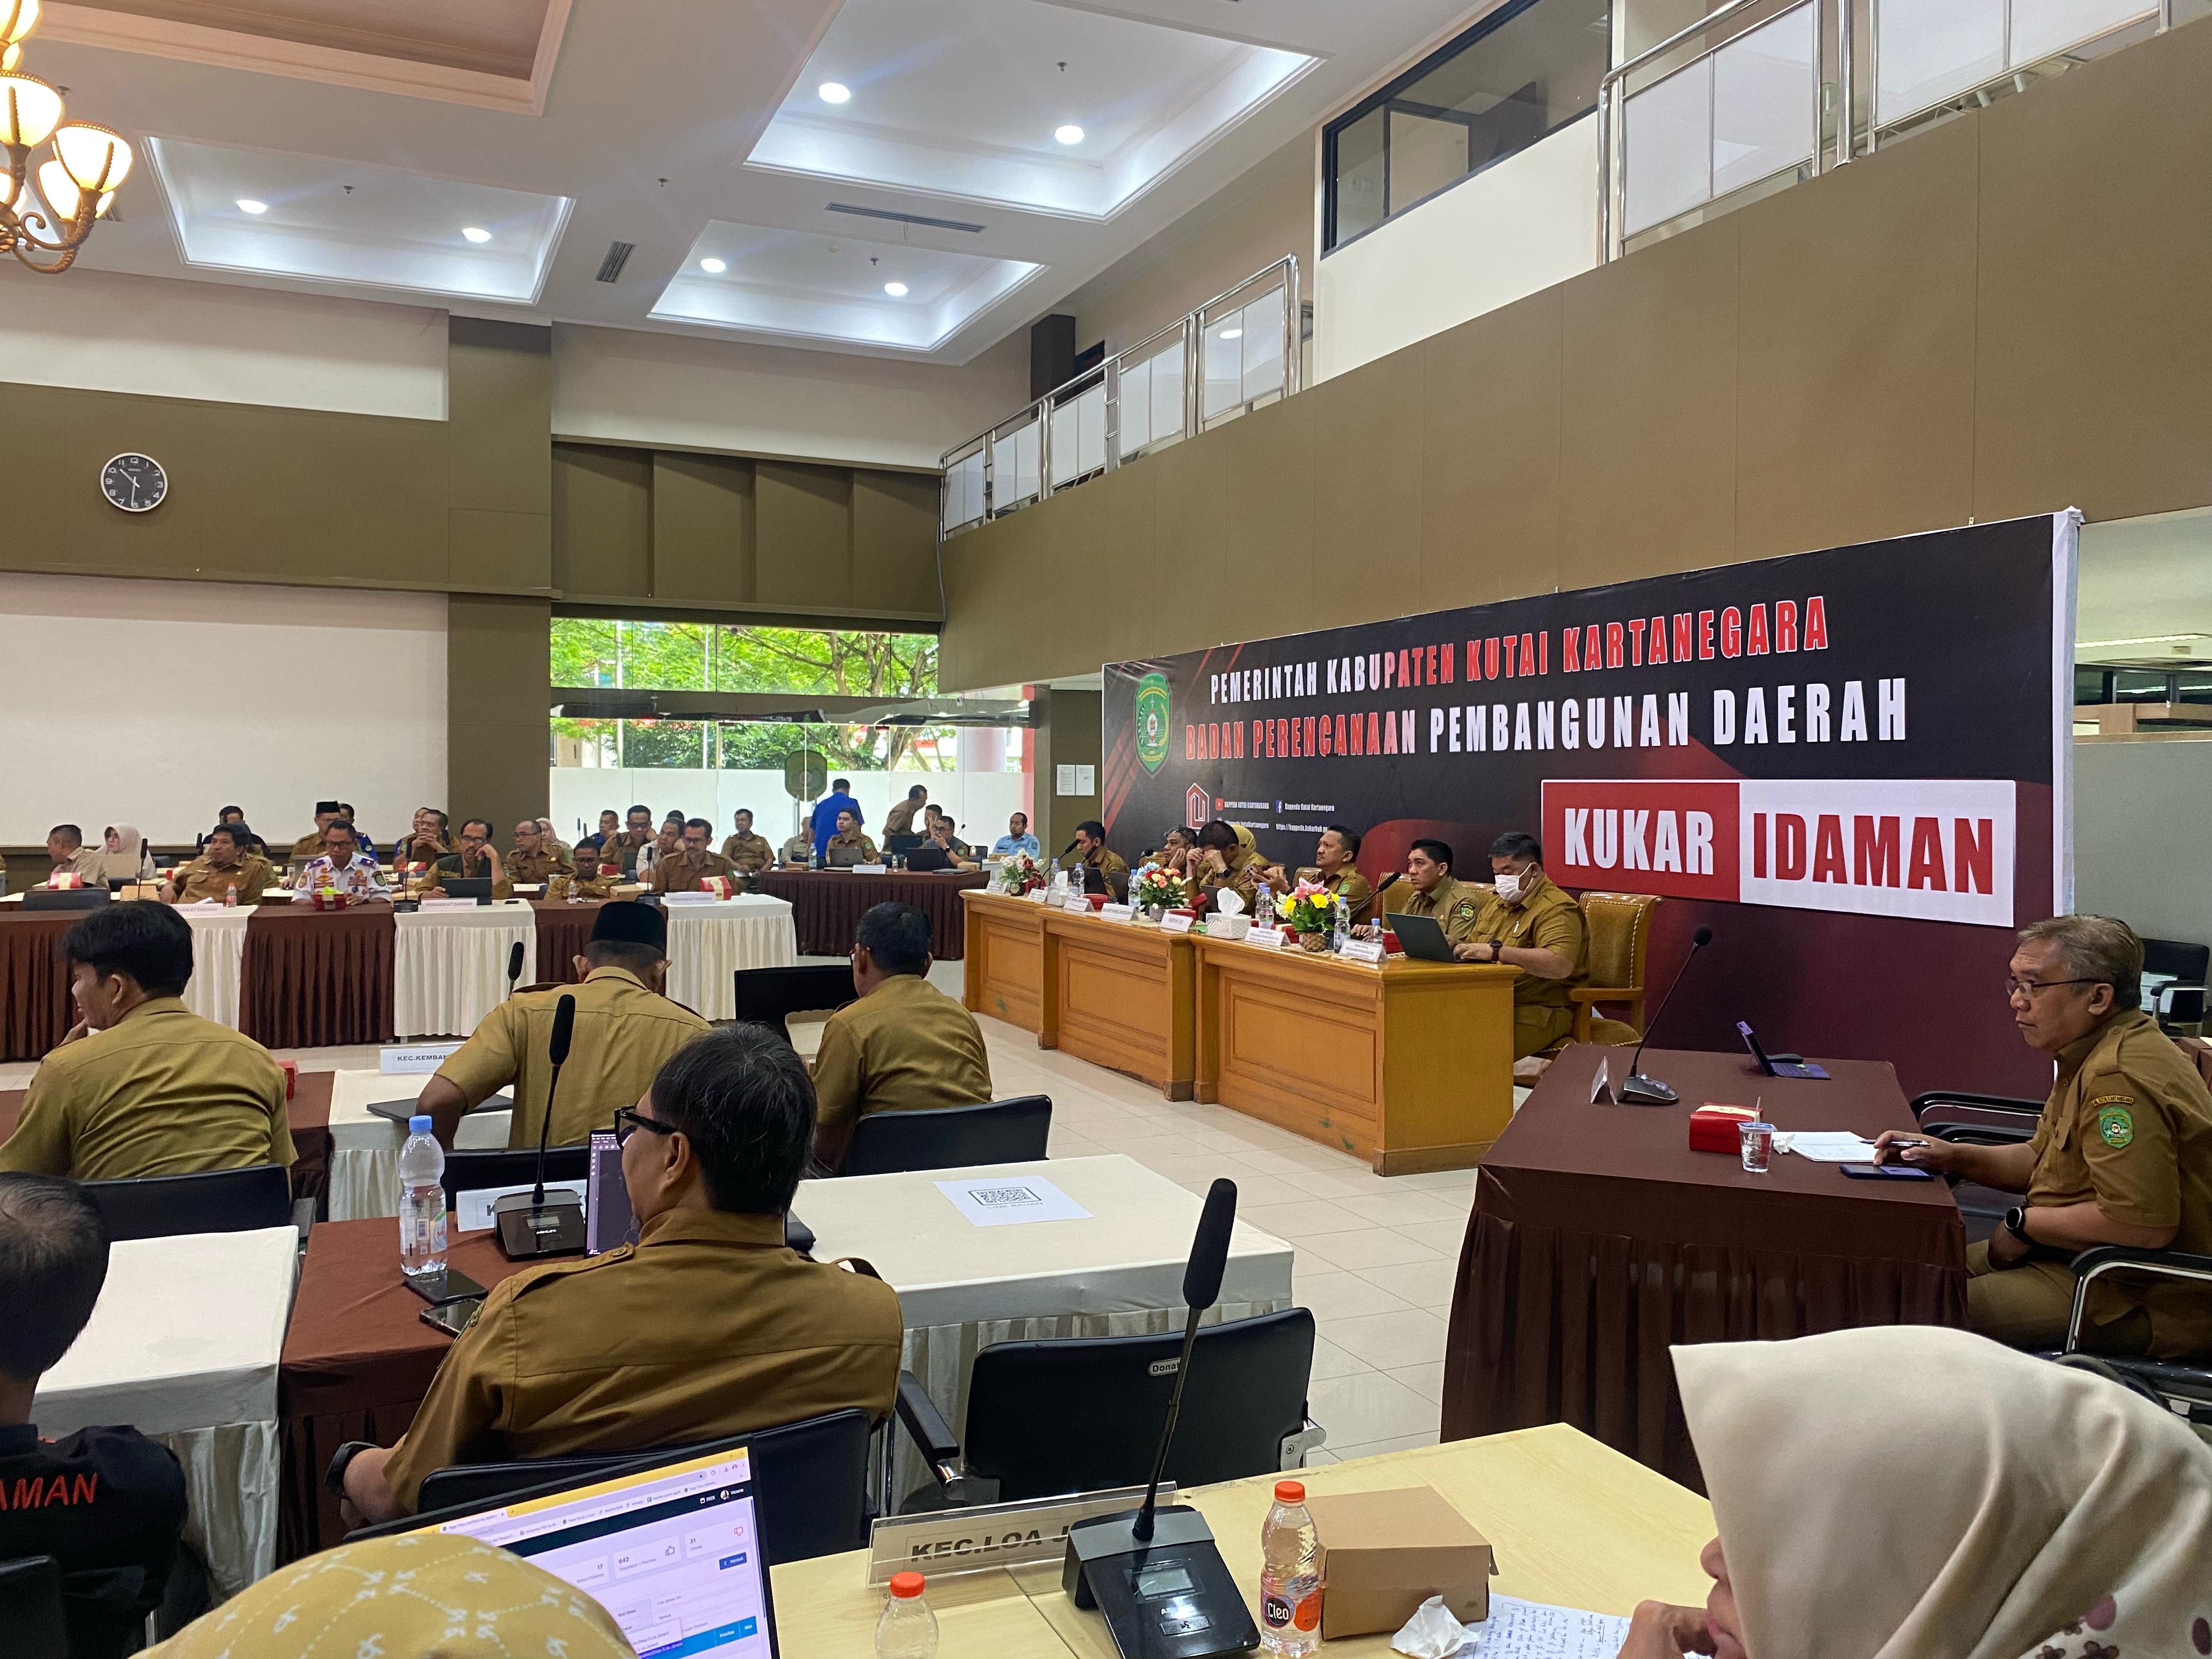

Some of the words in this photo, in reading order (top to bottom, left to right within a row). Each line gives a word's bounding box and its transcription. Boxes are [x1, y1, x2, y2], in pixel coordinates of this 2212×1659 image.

[1210, 661, 1317, 705] PEMERINTAH
[1327, 643, 1454, 694] KABUPATEN
[1466, 632, 1548, 681] KUTAI
[1562, 595, 1829, 673] KARTANEGARA
[1186, 720, 1244, 760] BADAN
[1252, 709, 1416, 759] PERENCANAAN
[1430, 692, 1689, 754] PEMBANGUNAN
[1713, 677, 1906, 746] DAERAH
[1564, 807, 1714, 876] KUKAR
[1753, 812, 1993, 896] IDAMAN
[911, 1530, 1042, 1562] KEC.LOA
[1266, 1602, 1289, 1621] Cleo
